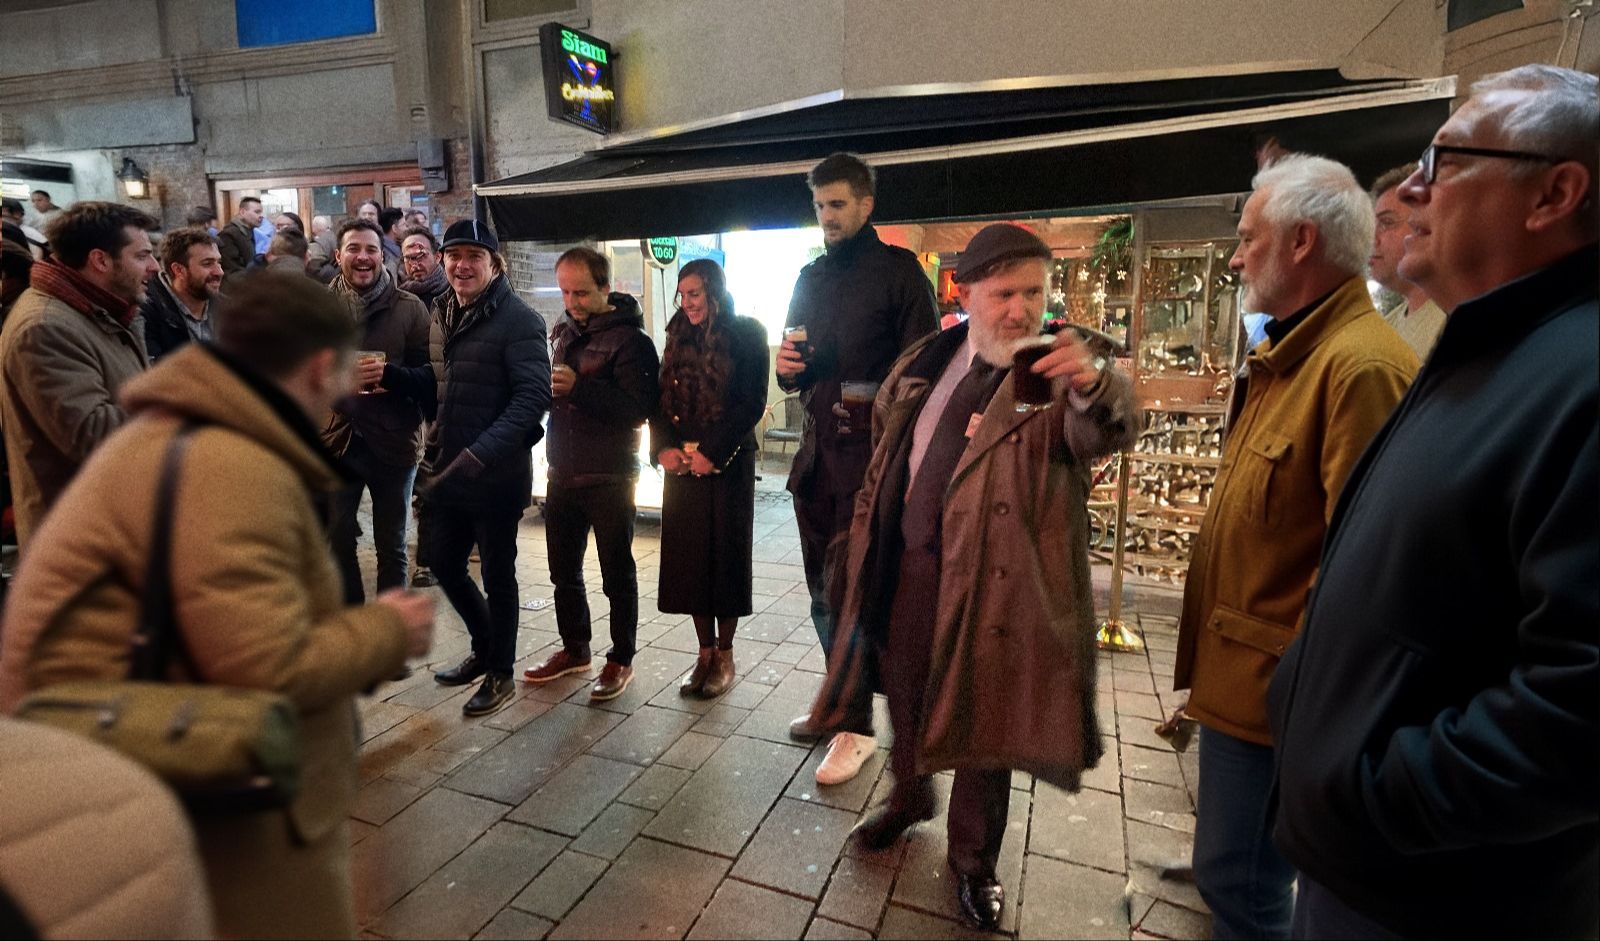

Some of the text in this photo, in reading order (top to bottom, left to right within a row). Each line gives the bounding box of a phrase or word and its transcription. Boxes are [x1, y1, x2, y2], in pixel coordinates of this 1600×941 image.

[561, 29, 608, 64] Siam
[654, 247, 663, 258] TO
[664, 247, 674, 259] GO
